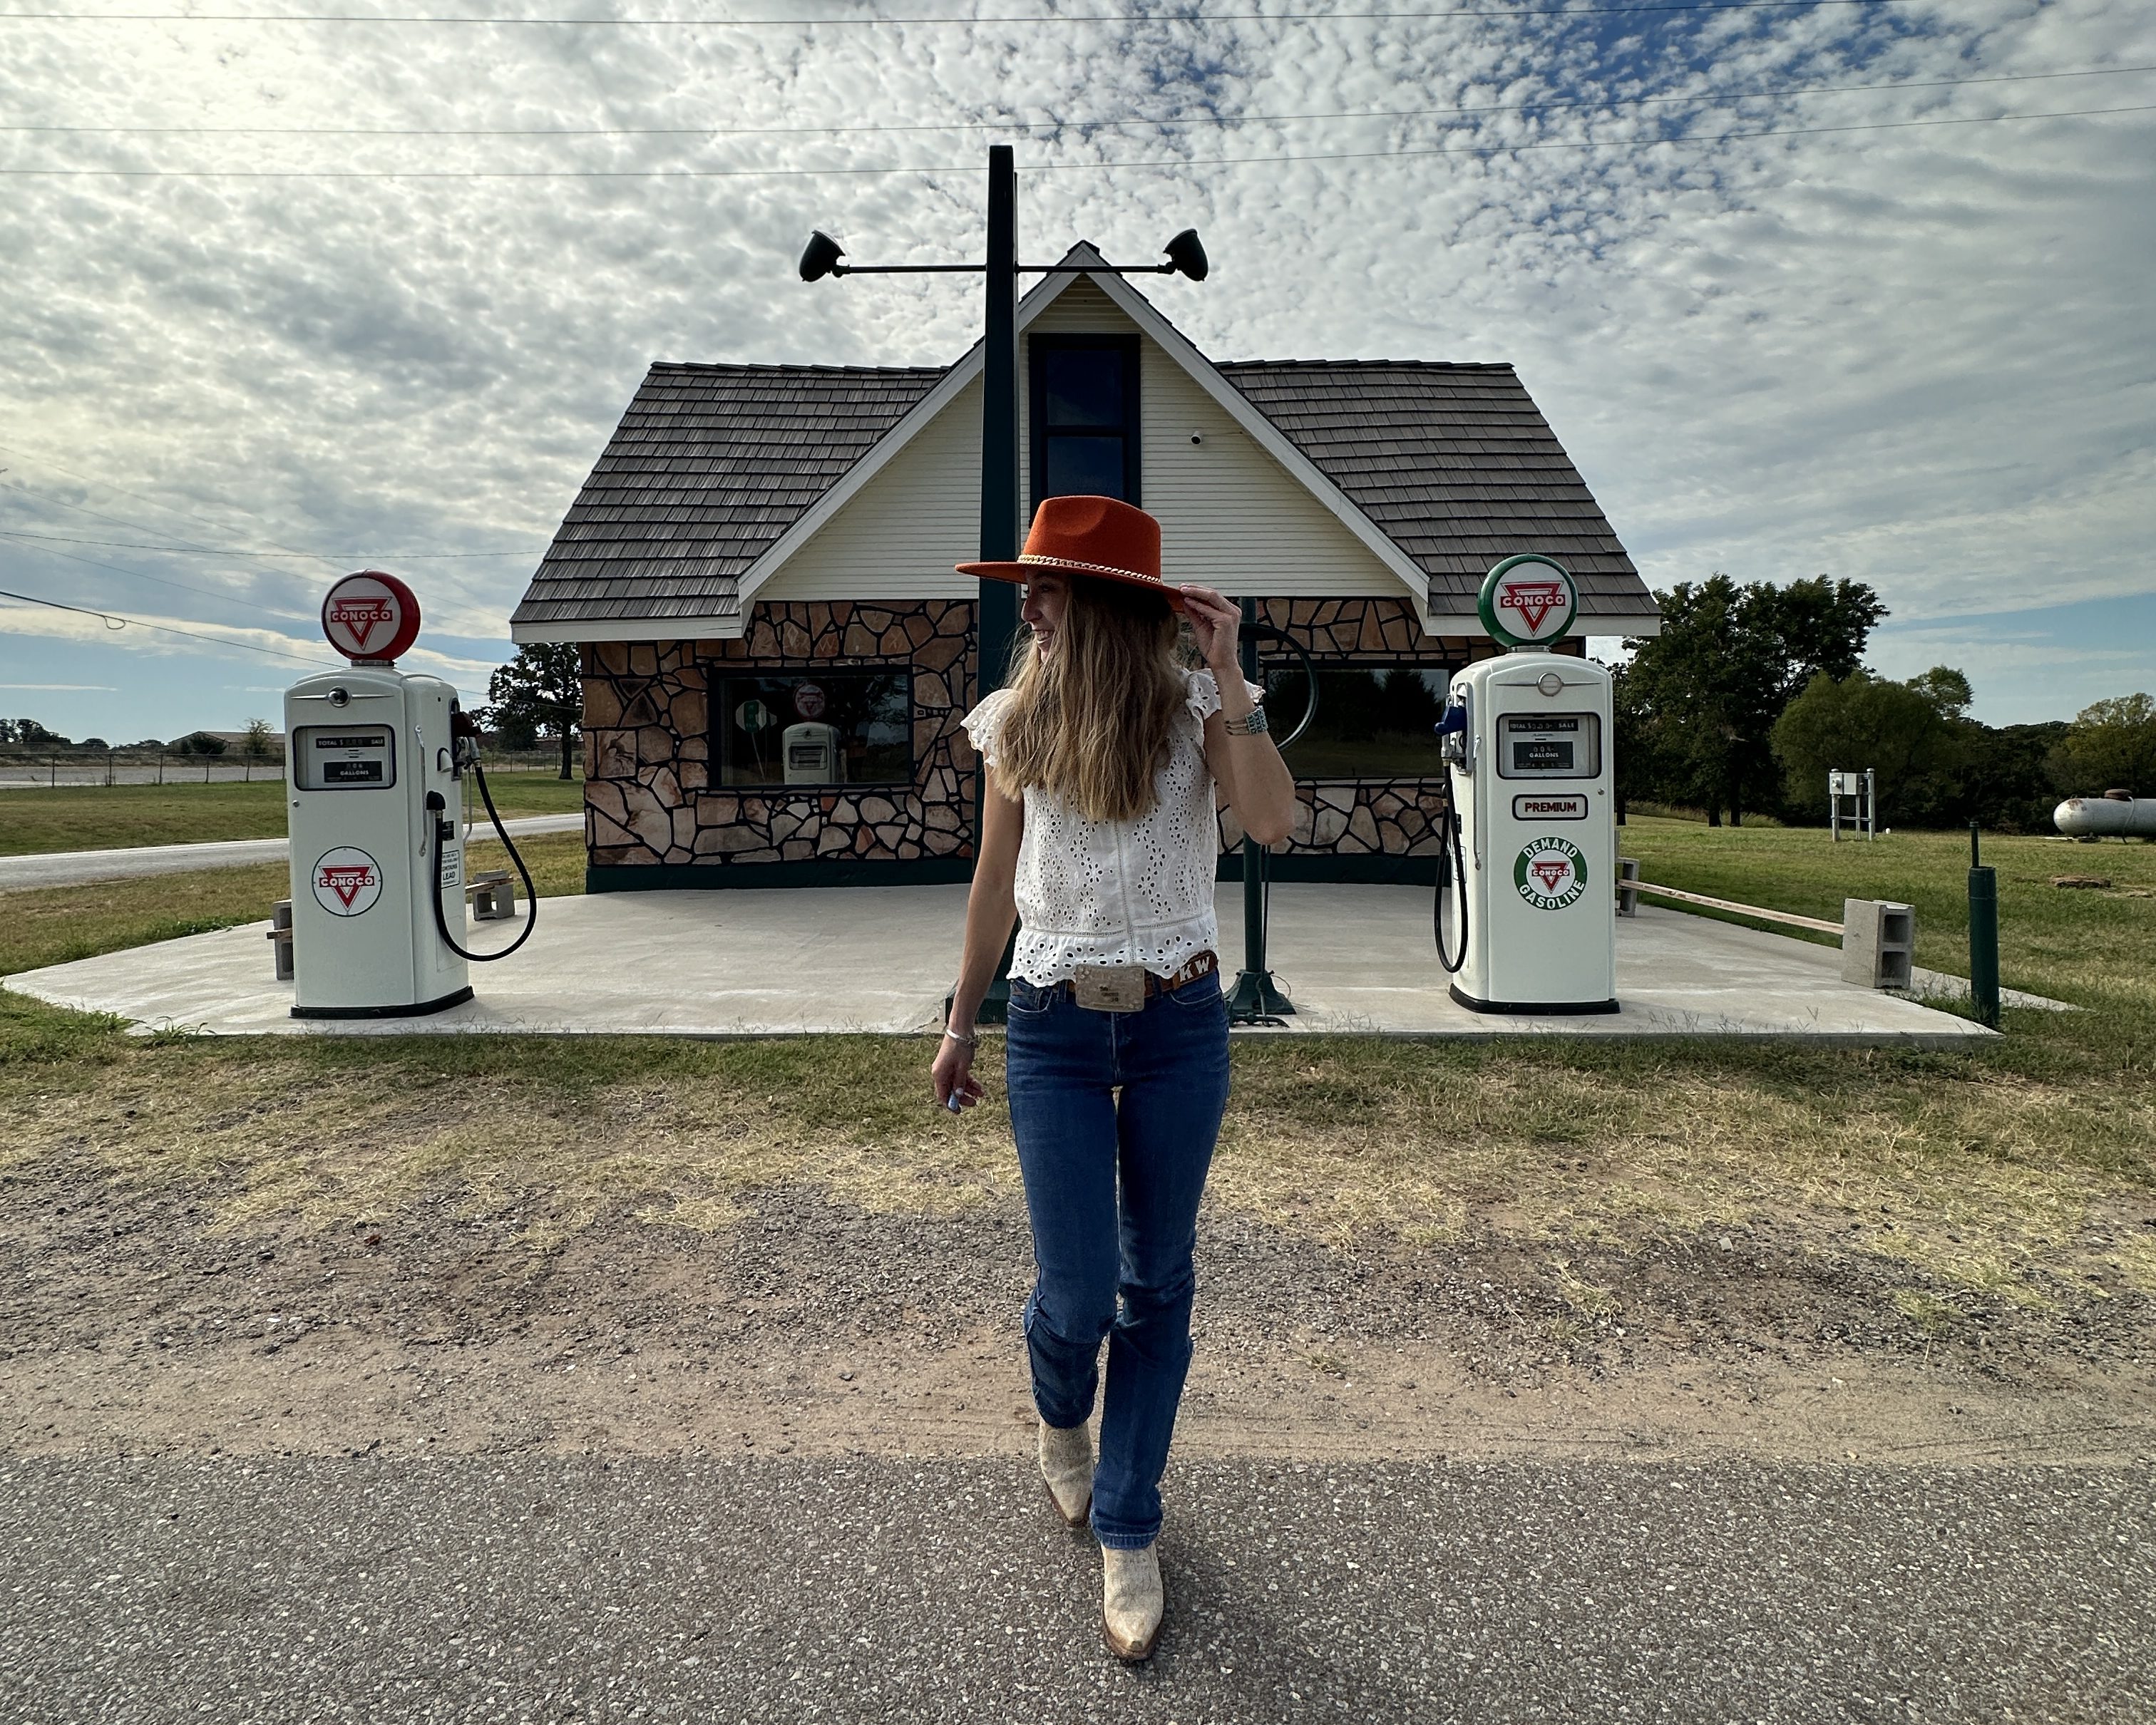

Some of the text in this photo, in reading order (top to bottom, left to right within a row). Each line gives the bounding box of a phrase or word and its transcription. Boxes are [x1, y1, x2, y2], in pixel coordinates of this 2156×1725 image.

[1502, 595, 1564, 607] CONOCO
[332, 610, 391, 621] CONOCO
[1525, 802, 1576, 812] PREMIUM
[1523, 838, 1578, 858] DEMAND
[443, 871, 456, 880] LEAD
[320, 877, 373, 886] CONOCO
[1519, 880, 1584, 910] GASOLINE
